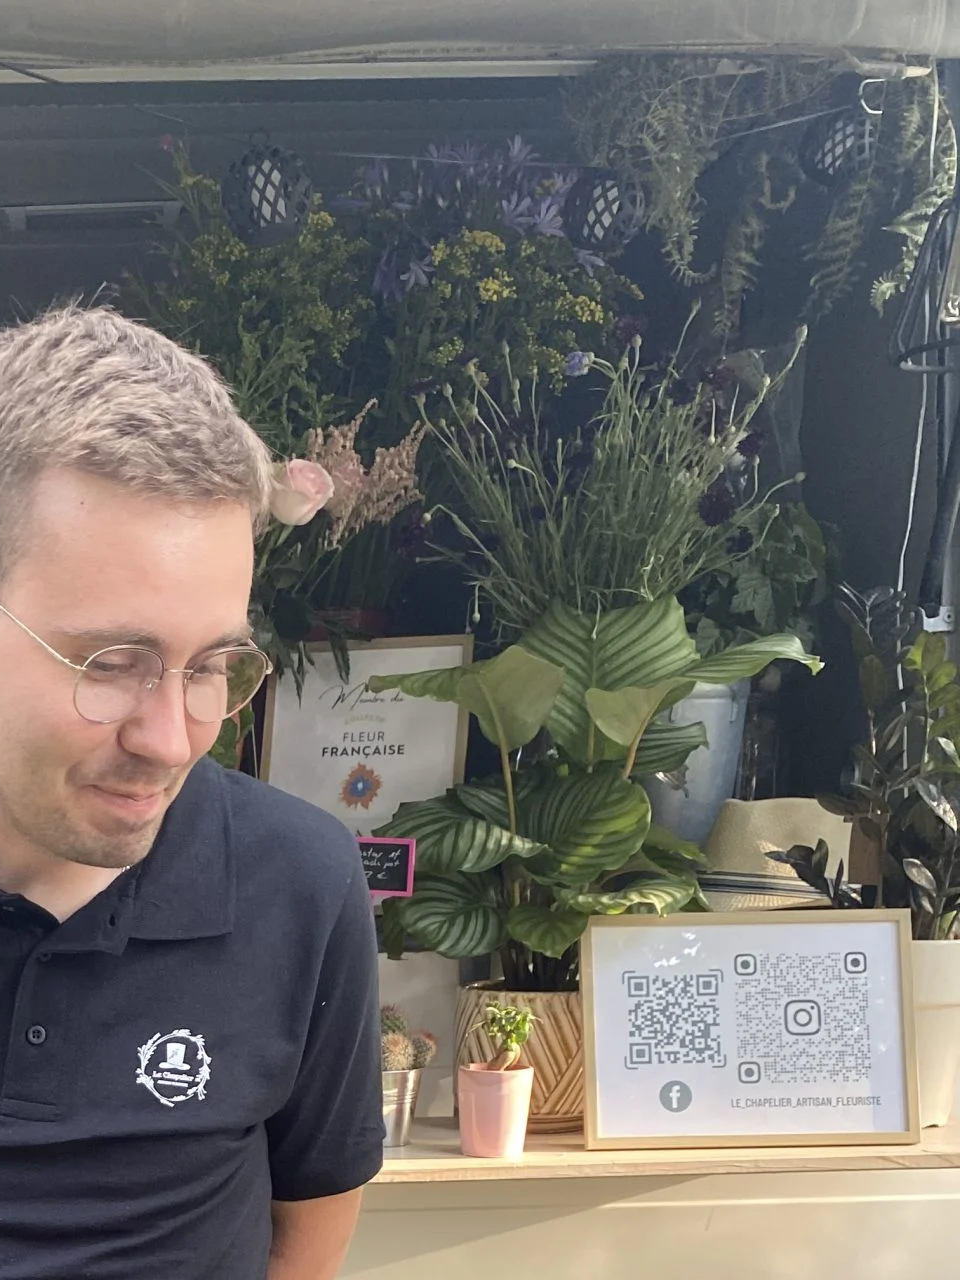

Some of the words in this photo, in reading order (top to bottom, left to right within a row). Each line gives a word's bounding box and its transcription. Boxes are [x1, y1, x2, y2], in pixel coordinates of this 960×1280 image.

[343, 731, 385, 743] FLEUR
[321, 744, 406, 759] FRANÇAISE
[730, 1095, 882, 1110] LE_CHAPELIER_ARTISAN_FLEURISTE
